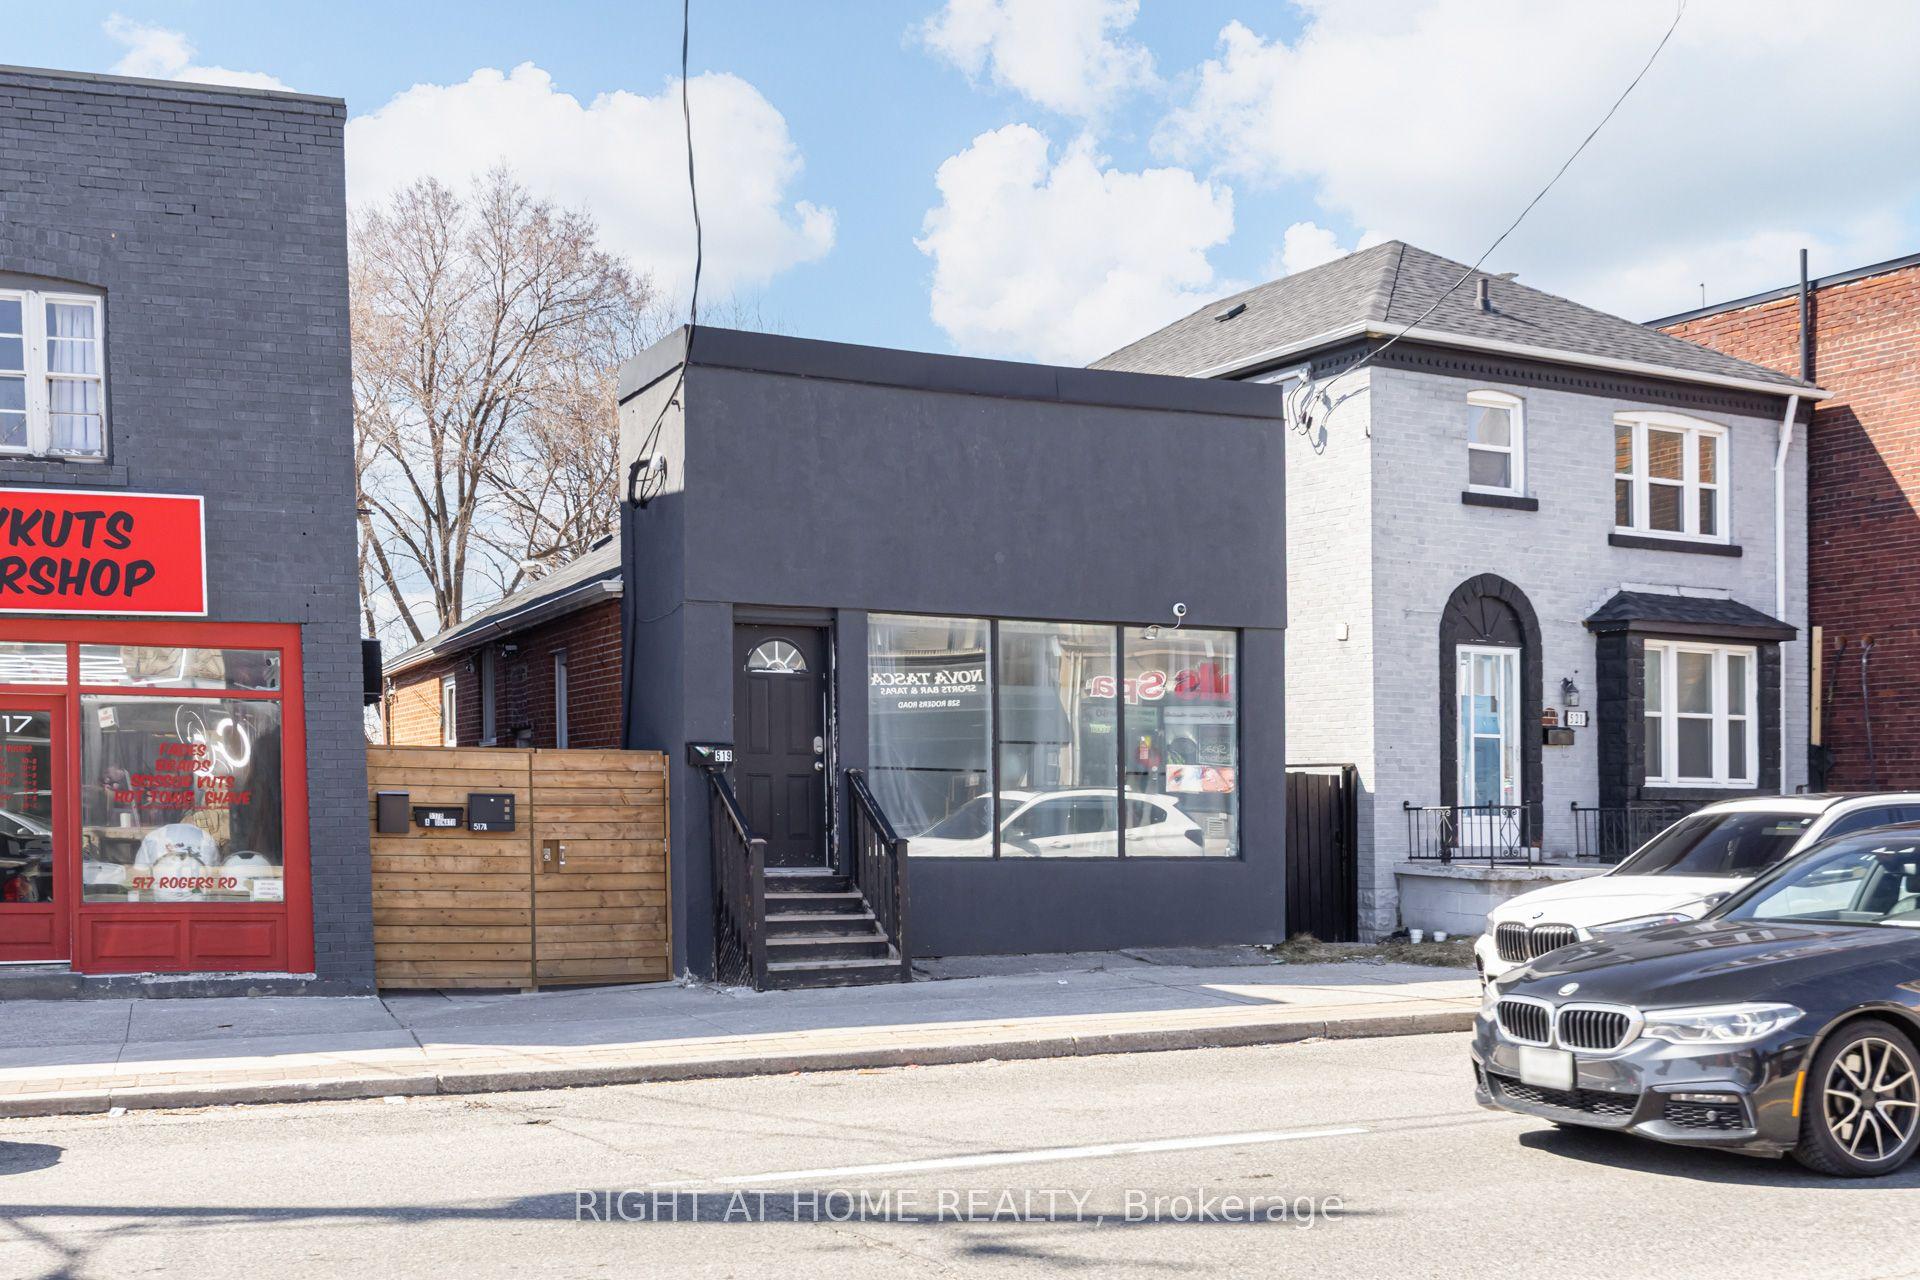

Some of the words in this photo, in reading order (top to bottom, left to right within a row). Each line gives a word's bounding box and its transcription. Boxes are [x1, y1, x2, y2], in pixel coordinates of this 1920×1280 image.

[1570, 713, 1583, 724] 521
[715, 750, 732, 761] 519
[473, 823, 488, 831] 517A
[132, 876, 155, 888] 517
[159, 876, 214, 889] ROGERS
[218, 876, 237, 888] RD
